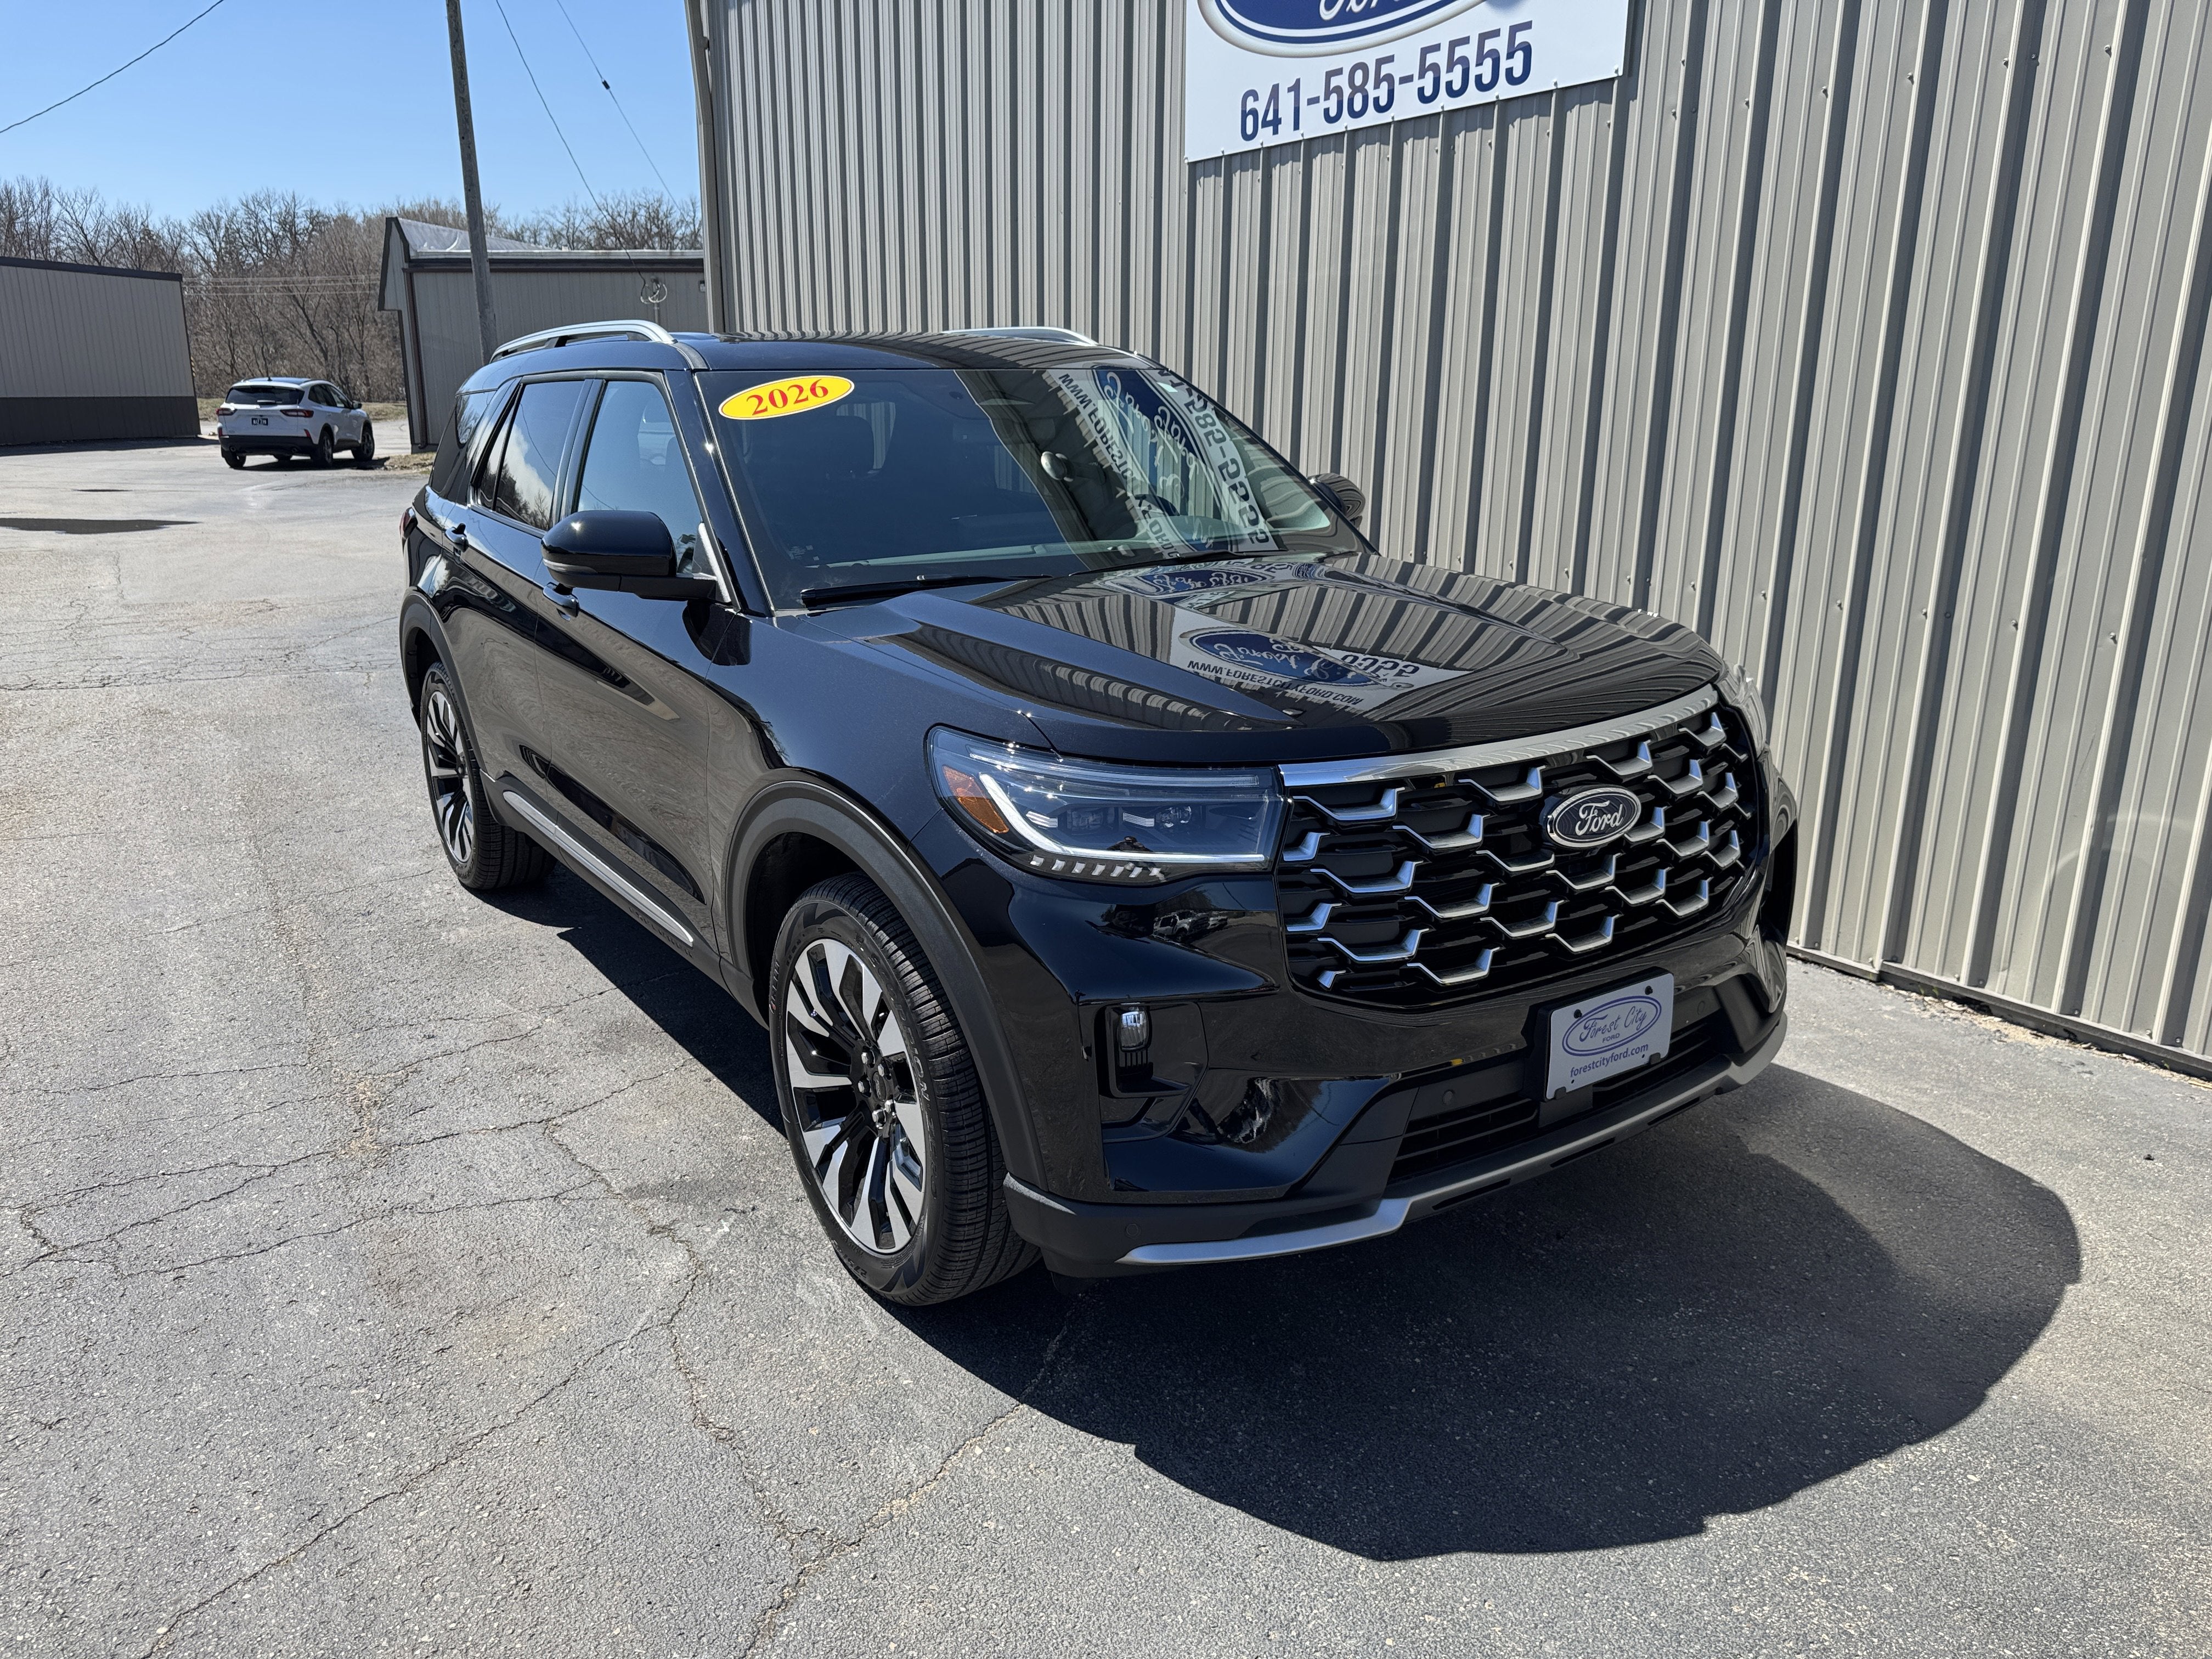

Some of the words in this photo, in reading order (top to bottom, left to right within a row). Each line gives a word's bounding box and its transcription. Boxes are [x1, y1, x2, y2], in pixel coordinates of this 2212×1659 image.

[1241, 20, 1533, 142] 641-585-5555
[747, 379, 828, 416] 2026
[1575, 800, 1623, 836] Ford
[1579, 1014, 1621, 1042] Forest
[1623, 1006, 1646, 1031] City
[1602, 1032, 1620, 1043] FORD
[1570, 1043, 1649, 1077] forestcityford.com
